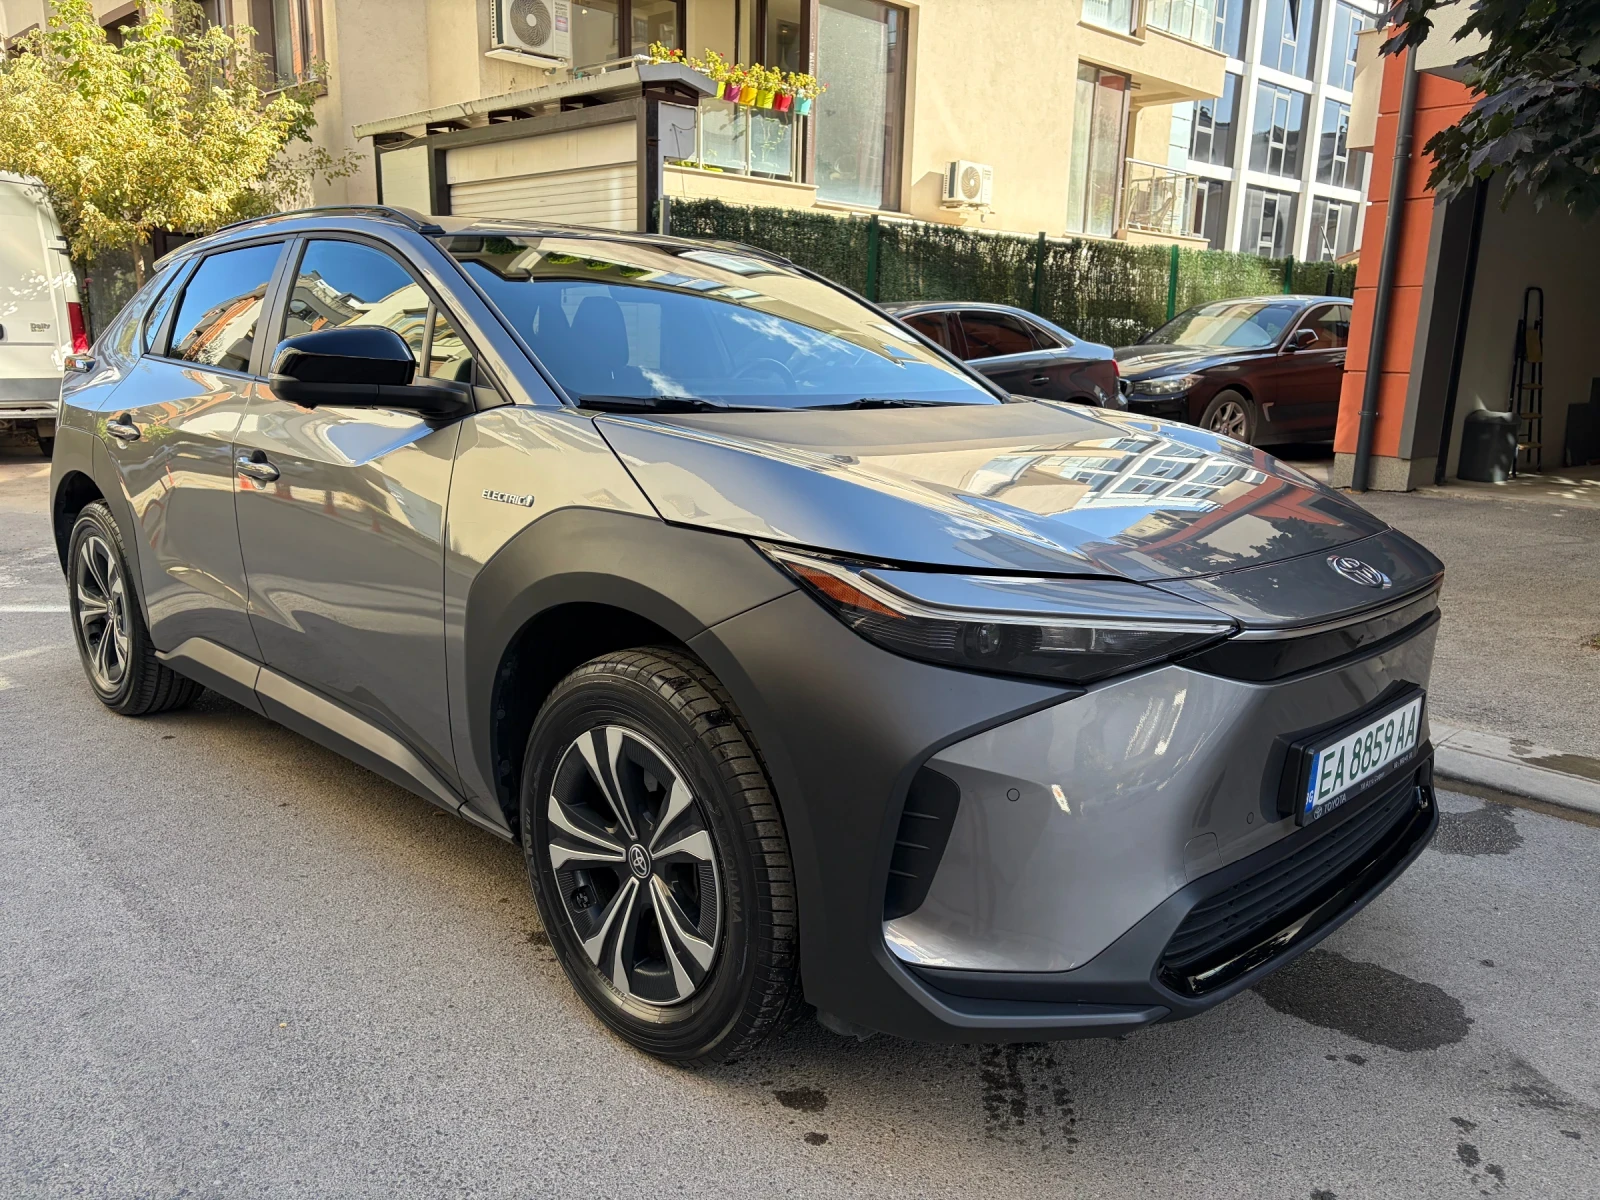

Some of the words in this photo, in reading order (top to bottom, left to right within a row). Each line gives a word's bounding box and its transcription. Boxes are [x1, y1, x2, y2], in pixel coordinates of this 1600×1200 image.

[482, 489, 526, 506] ELECTRIC
[1318, 746, 1346, 800] EA
[1350, 718, 1395, 780] 8859
[1395, 705, 1417, 755] AA
[1324, 793, 1347, 813] TOYOTA
